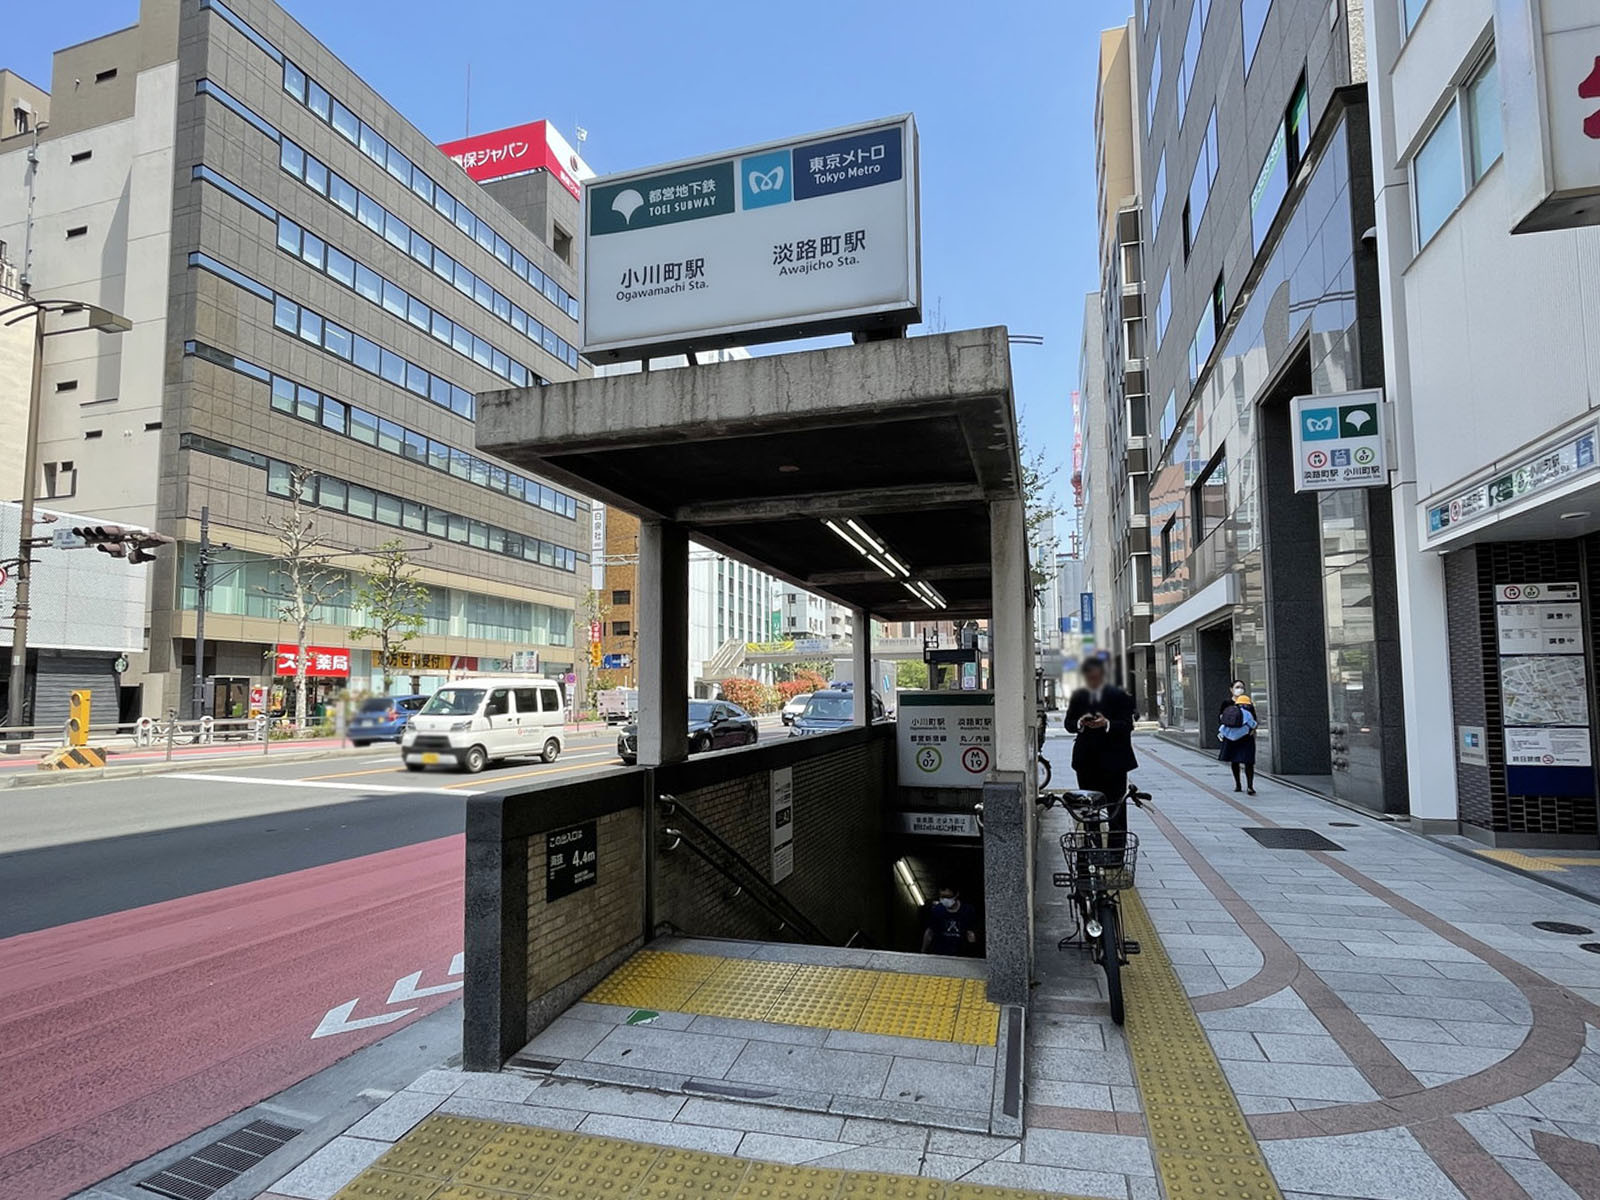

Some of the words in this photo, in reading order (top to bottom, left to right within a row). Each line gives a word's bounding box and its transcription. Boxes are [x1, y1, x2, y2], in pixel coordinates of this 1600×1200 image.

[809, 145, 885, 174] 東京メトロ
[814, 169, 846, 185] Tokyo
[848, 163, 881, 179] Metro
[649, 180, 717, 203] 都営地下鉄
[649, 203, 671, 217] TOEI
[674, 196, 716, 213] SUBWAY
[772, 230, 866, 265] 淡路町駅
[620, 258, 706, 289] 小川町駅
[779, 258, 834, 277] Awajicho
[837, 256, 860, 269] Sta.
[616, 281, 686, 302] Ogawamachi
[688, 279, 709, 291] Sta.
[1344, 466, 1380, 476] 小川町駅
[912, 718, 945, 726] 小川町駅
[573, 851, 595, 866] 4.4m
